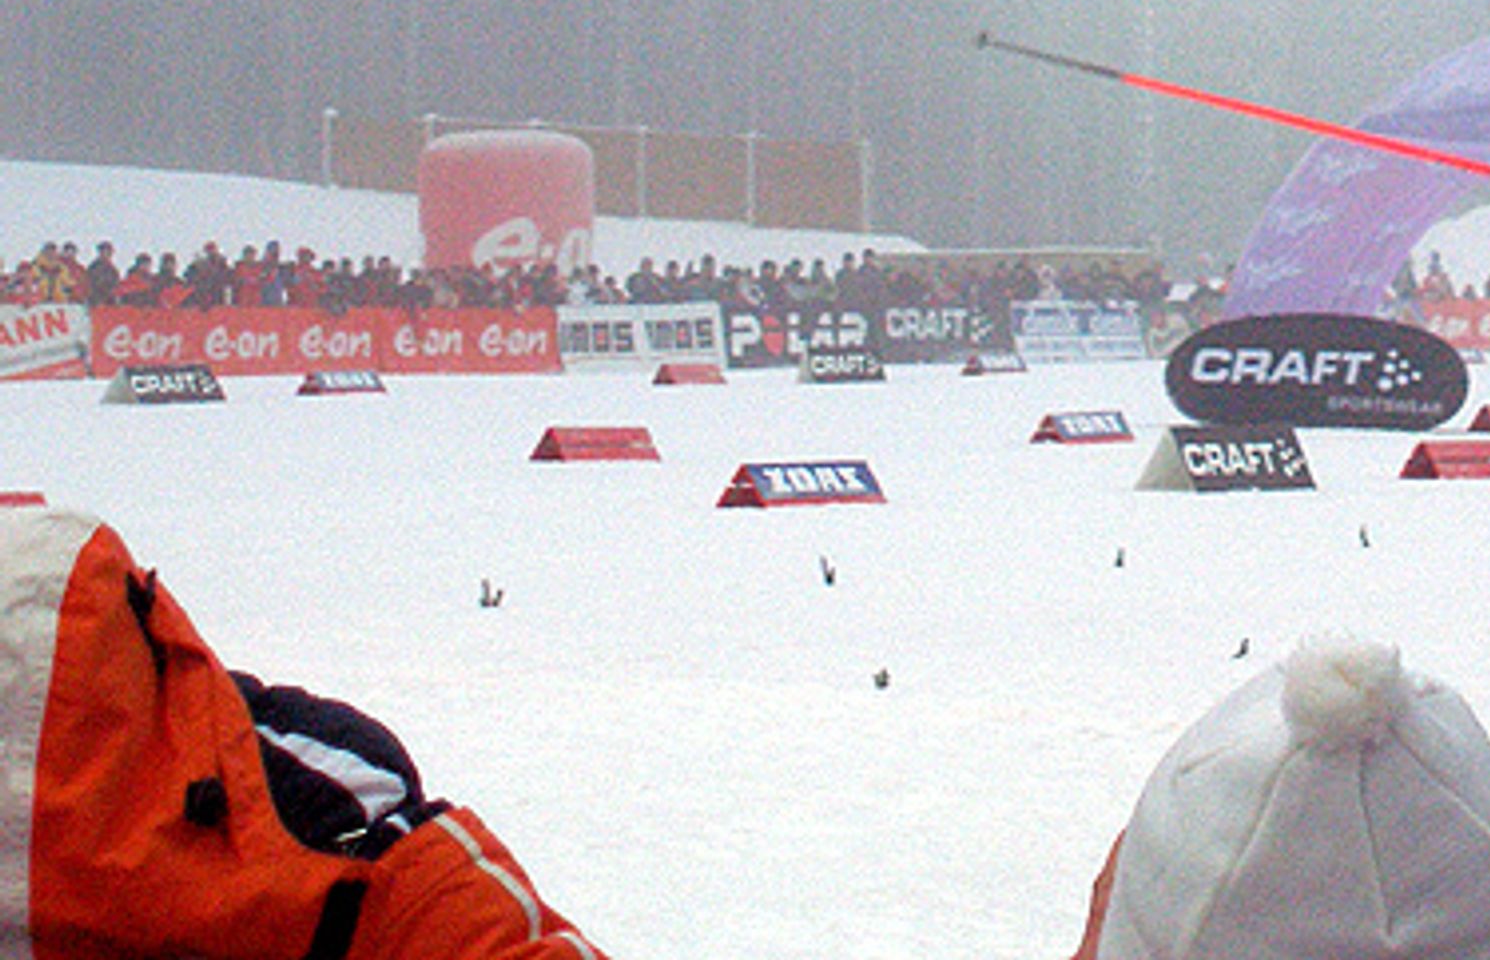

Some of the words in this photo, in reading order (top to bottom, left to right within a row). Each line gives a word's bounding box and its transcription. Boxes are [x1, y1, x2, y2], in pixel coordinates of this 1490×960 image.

[730, 312, 868, 358] POLAR
[886, 307, 967, 339] CRAFT
[1190, 346, 1376, 385] CRAFT
[1183, 441, 1273, 477] CRAFT
